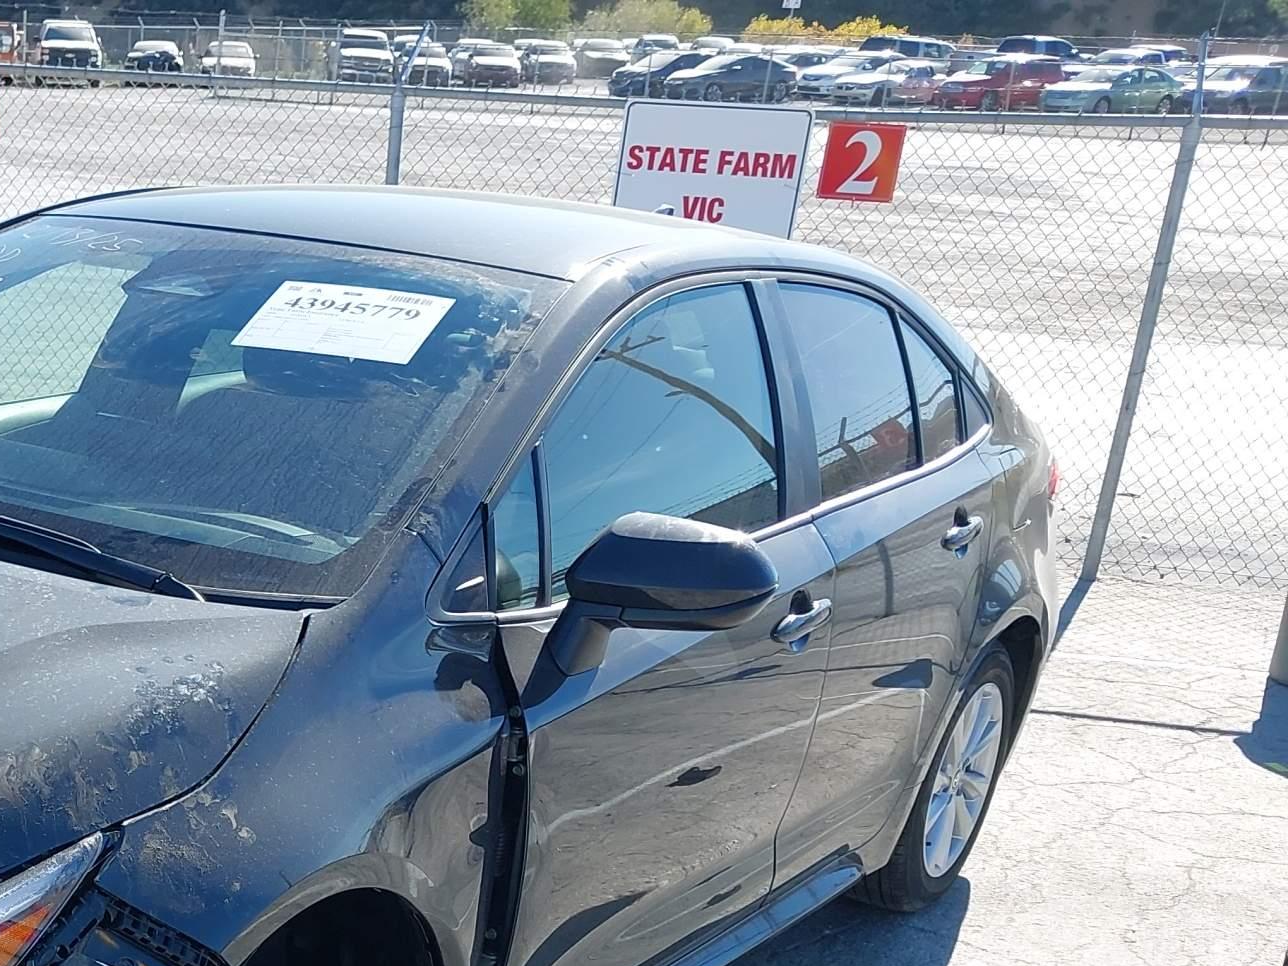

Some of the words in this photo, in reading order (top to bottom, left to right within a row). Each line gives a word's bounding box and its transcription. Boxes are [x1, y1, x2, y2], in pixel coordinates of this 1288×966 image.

[626, 145, 710, 175] STATE
[717, 150, 797, 180] FARM
[836, 130, 883, 195] 2
[681, 195, 726, 224] VIC
[283, 296, 421, 321] 43945779
